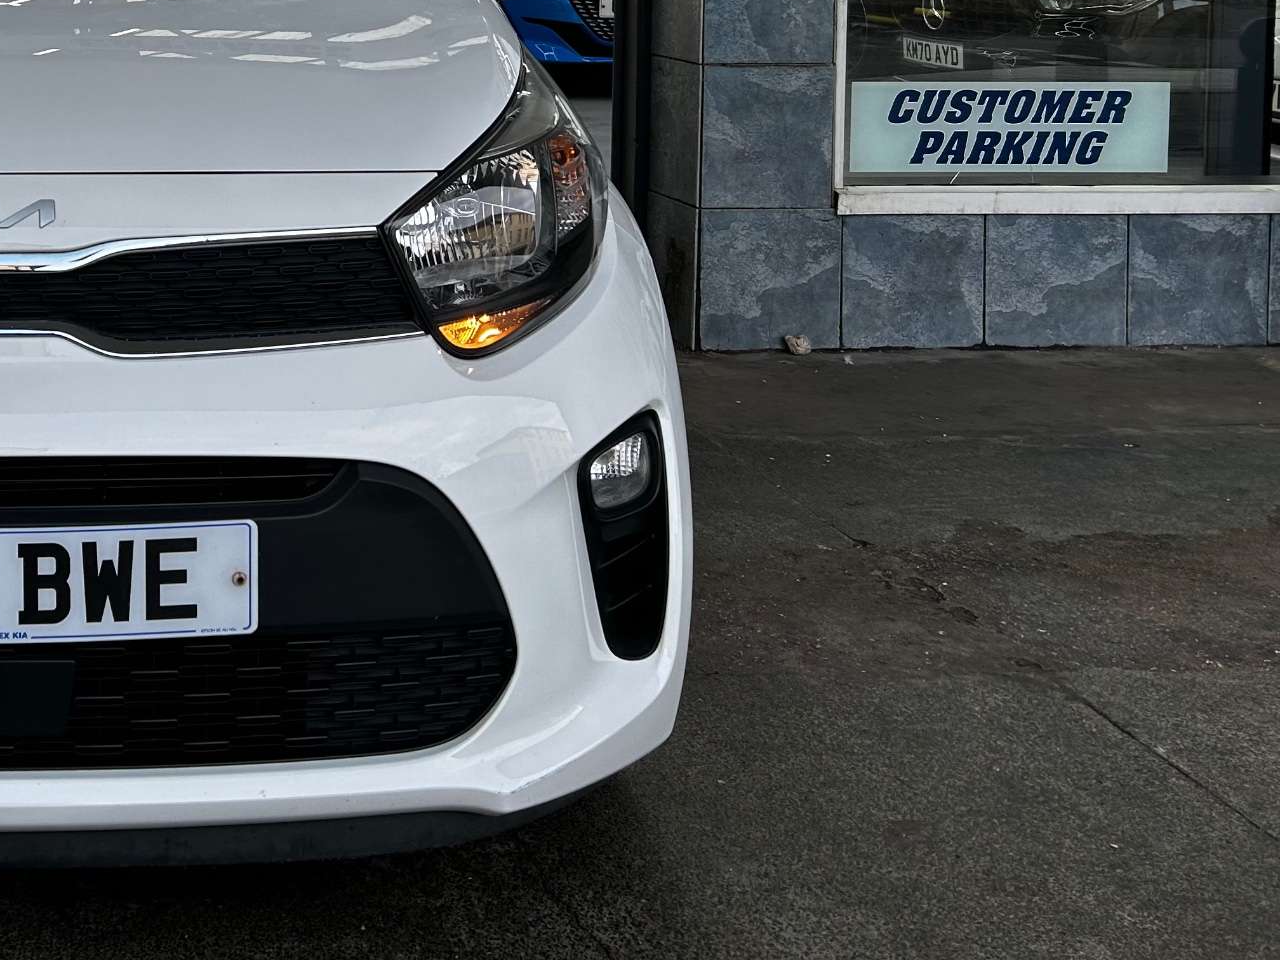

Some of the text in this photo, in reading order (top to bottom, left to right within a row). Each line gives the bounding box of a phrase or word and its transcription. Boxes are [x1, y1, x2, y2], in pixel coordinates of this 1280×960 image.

[906, 39, 959, 66] KM70 AYD
[887, 89, 1132, 125] CUSTOMER
[908, 130, 1108, 166] PARKING
[17, 537, 198, 626] BWE
